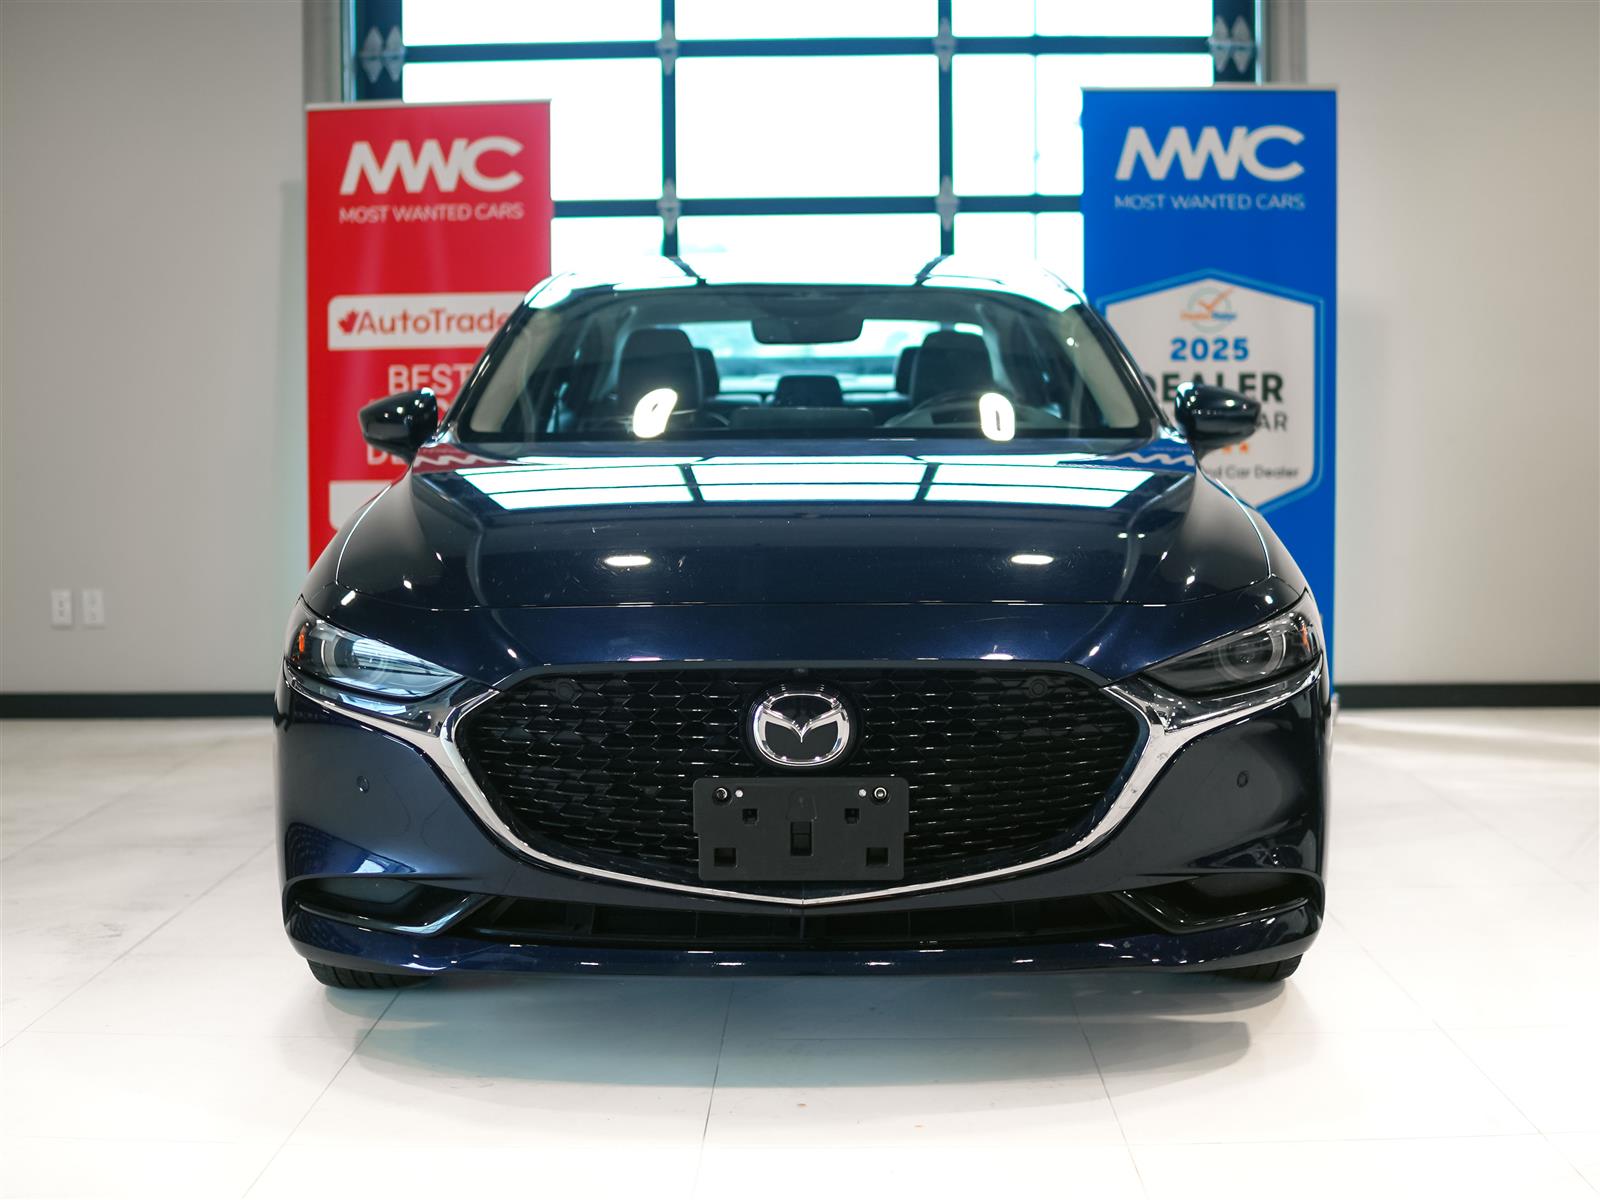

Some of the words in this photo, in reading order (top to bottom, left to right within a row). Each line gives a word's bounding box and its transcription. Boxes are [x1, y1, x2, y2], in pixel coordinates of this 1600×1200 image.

[339, 136, 524, 195] MWC
[1115, 125, 1305, 182] MWC
[339, 205, 388, 224] MOST
[392, 203, 473, 222] WANTED
[474, 201, 525, 221] CARS
[1114, 194, 1165, 211] MOST
[1171, 193, 1251, 210] WANTED
[1255, 192, 1306, 211] CARS
[1170, 337, 1250, 361] 2025
[388, 363, 475, 396] BEST
[1254, 463, 1299, 480] Dealer
